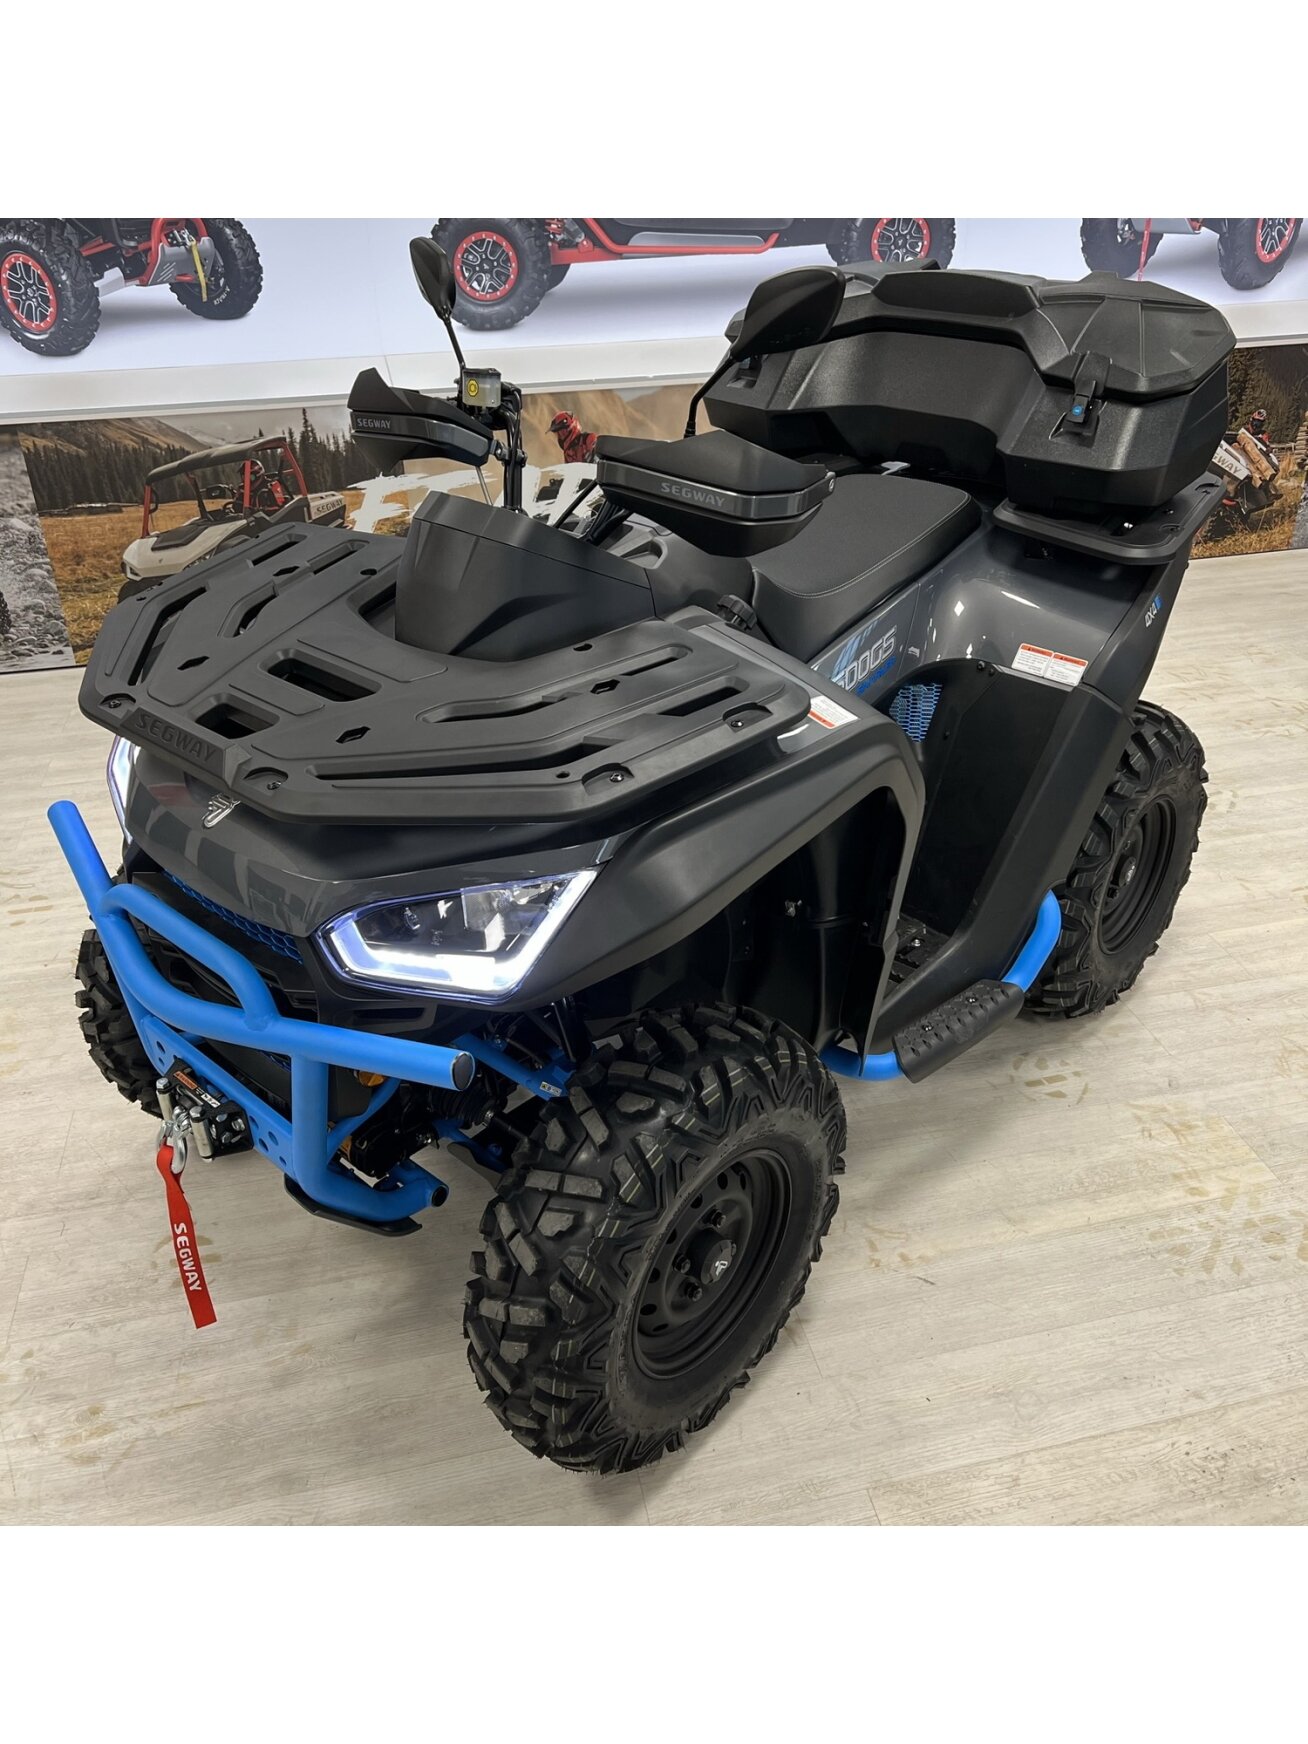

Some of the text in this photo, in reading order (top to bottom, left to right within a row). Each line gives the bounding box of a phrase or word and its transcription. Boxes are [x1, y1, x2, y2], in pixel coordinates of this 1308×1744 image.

[356, 418, 391, 429] SEGWAY
[660, 482, 726, 507] SEGWAY
[135, 713, 217, 763] SEGWAY
[173, 1222, 202, 1291] SEGWAY
